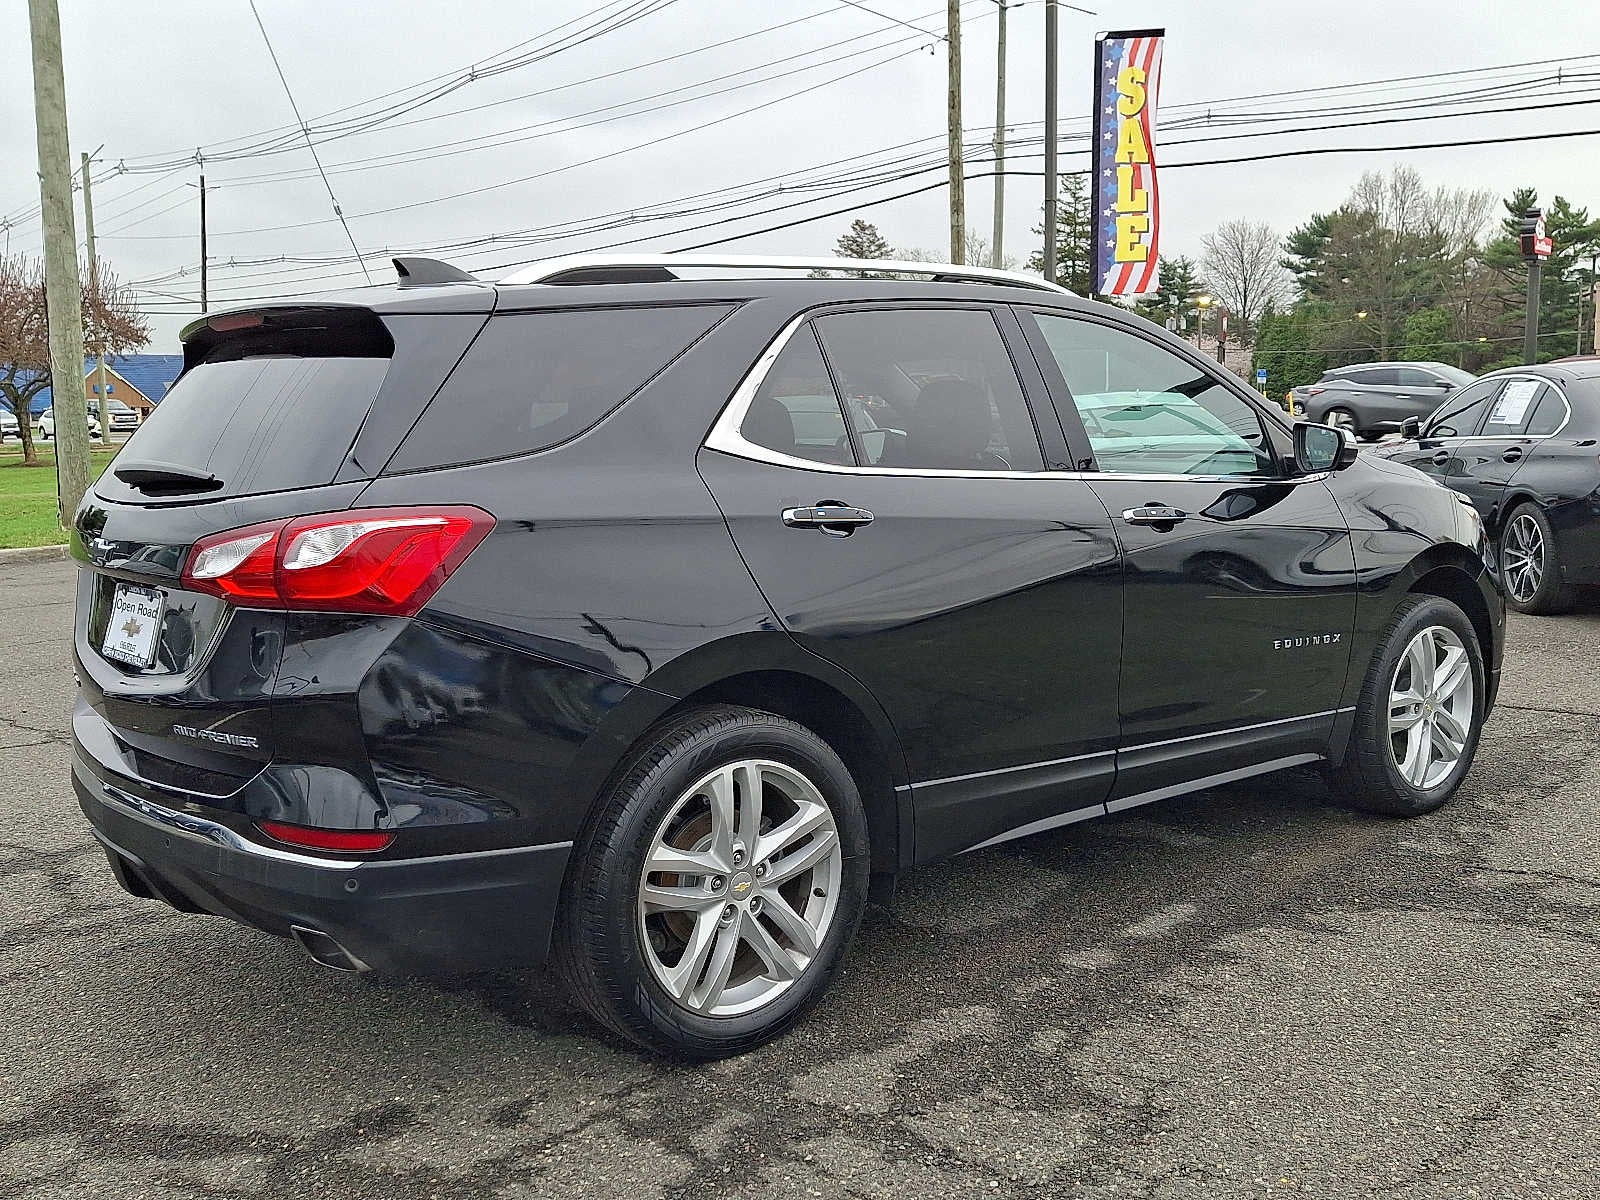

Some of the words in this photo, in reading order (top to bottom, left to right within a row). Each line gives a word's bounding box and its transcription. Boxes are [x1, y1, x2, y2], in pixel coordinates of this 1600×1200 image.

[1114, 65, 1150, 264] SALE
[116, 598, 136, 614] Open
[137, 603, 158, 619] Road
[1273, 633, 1341, 650] EQUINOX
[198, 729, 259, 748] PREMIER
